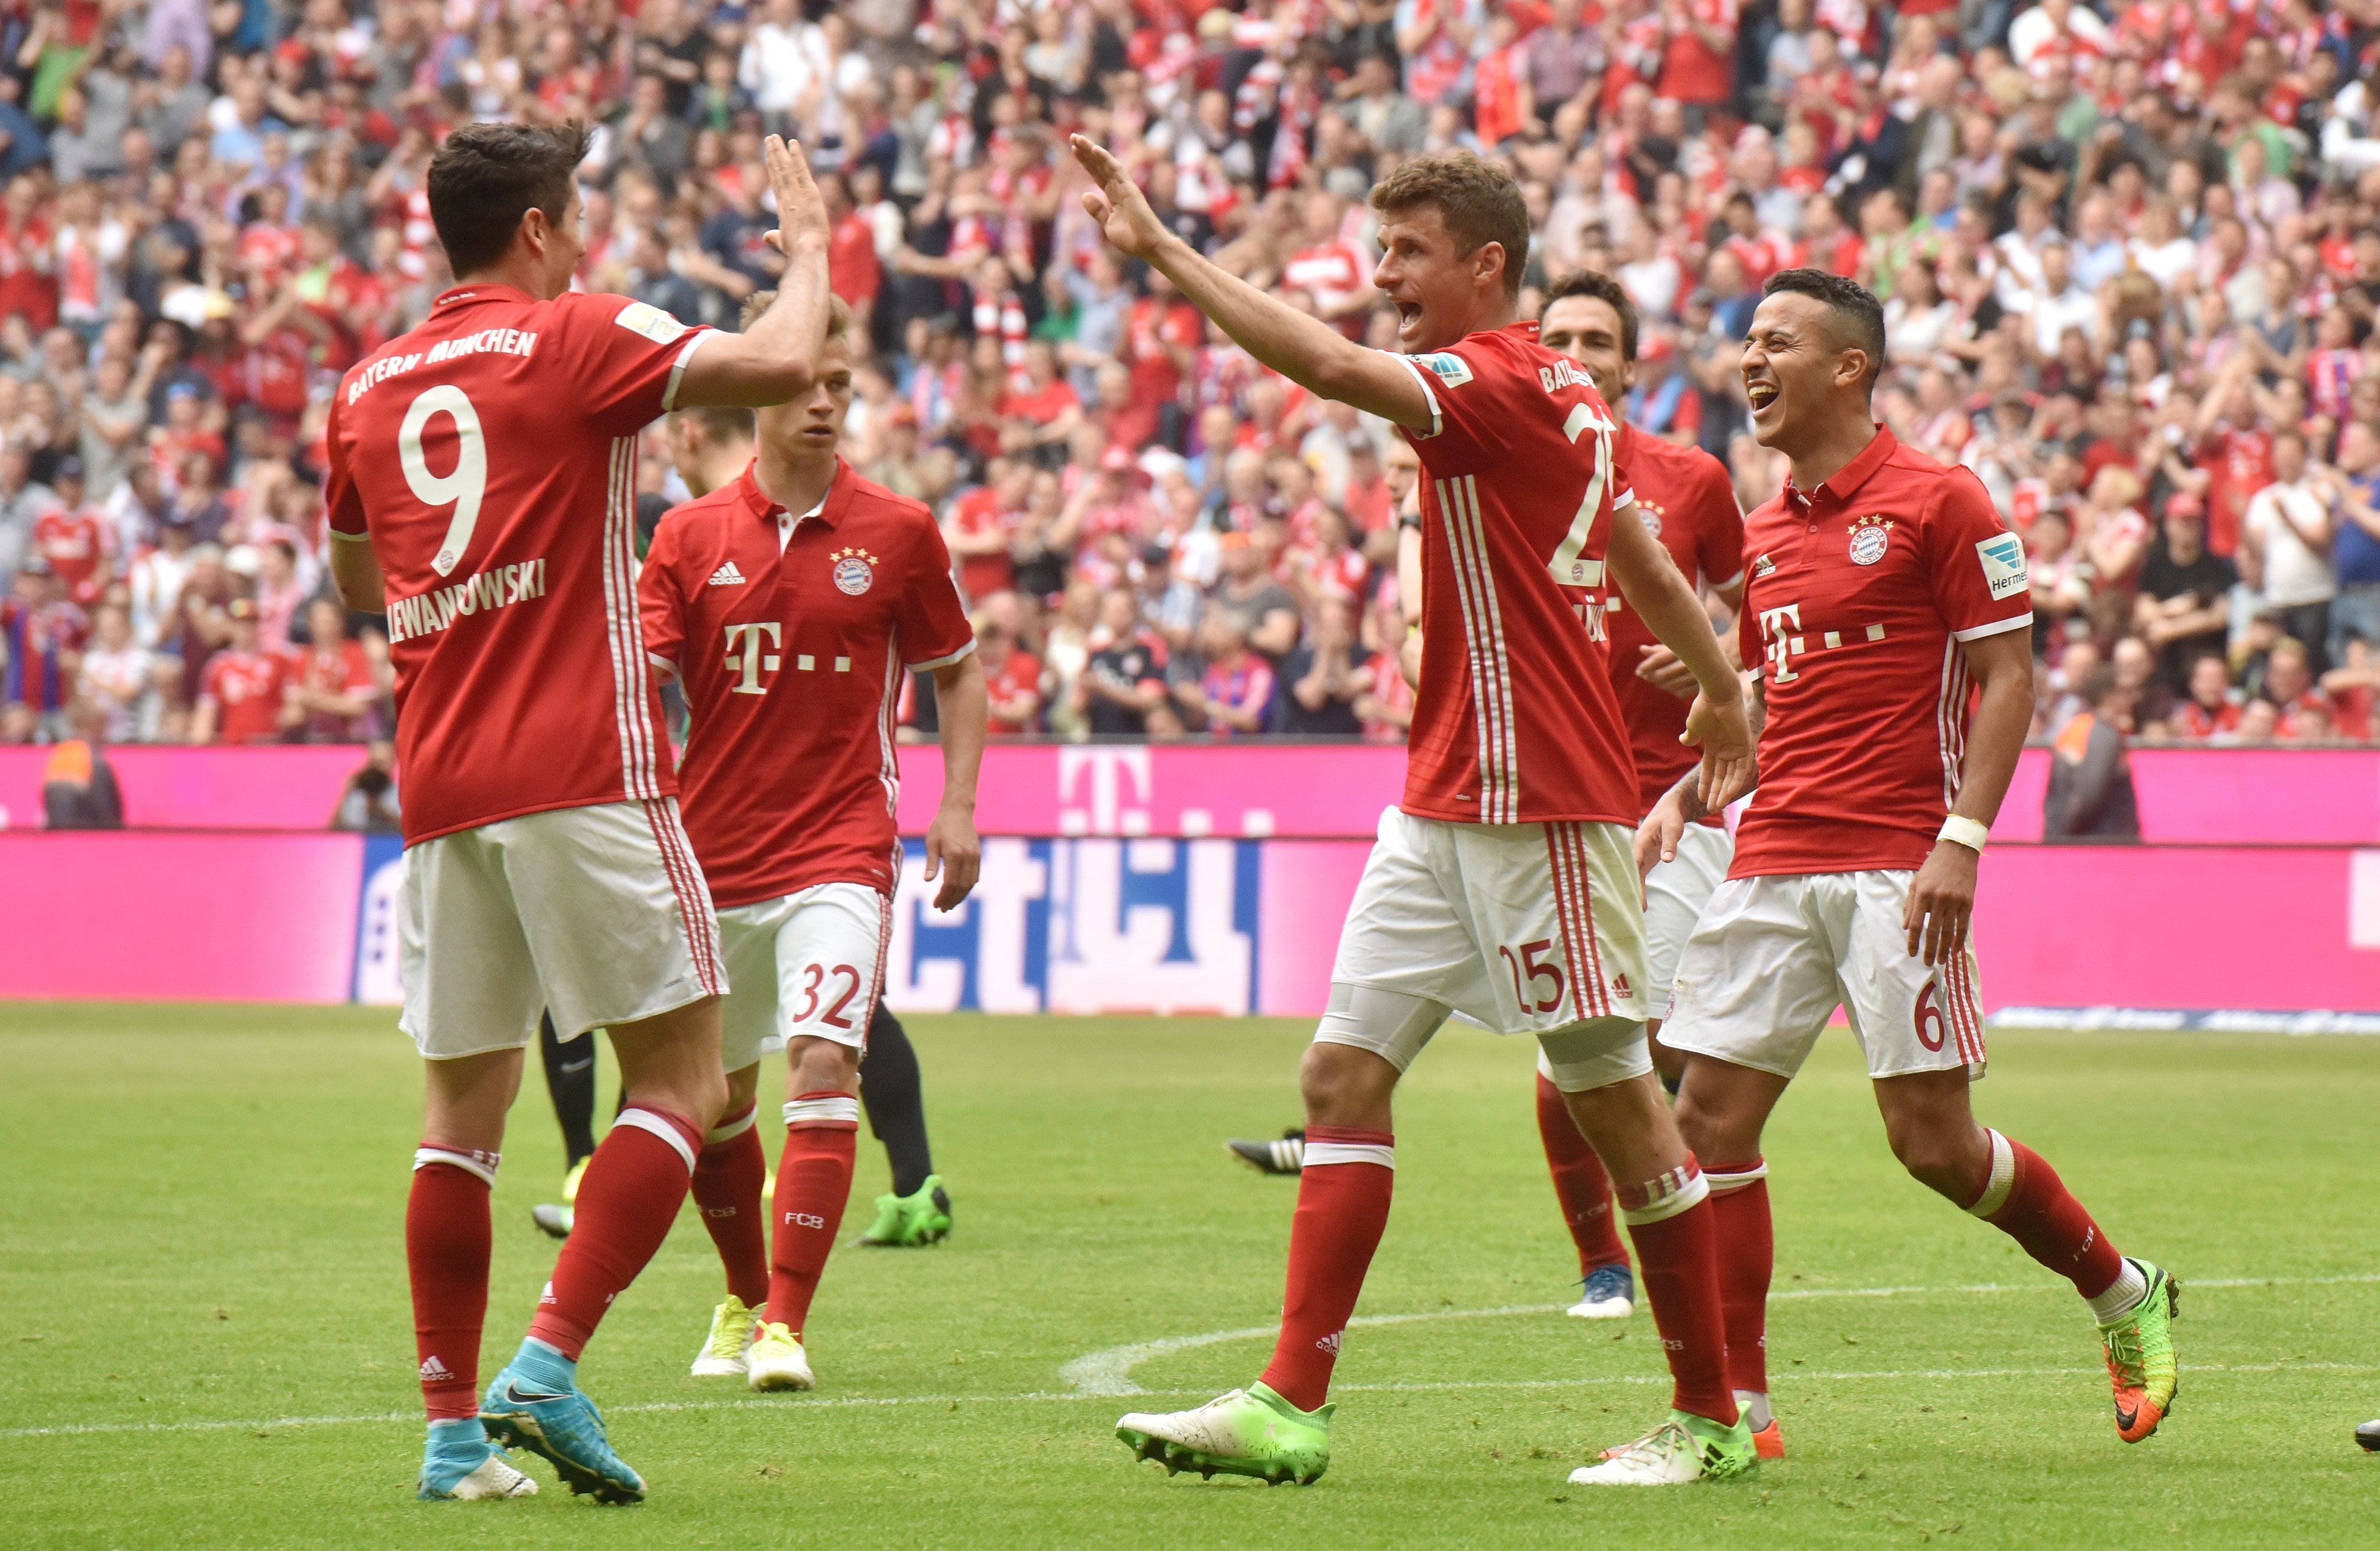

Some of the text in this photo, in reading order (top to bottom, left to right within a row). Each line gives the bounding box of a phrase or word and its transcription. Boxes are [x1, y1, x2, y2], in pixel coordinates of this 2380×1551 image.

[349, 353, 422, 406] BAYERN
[398, 384, 487, 577] 9
[1860, 529, 1885, 542] BAYERN
[708, 576, 746, 585] adidas
[1992, 571, 2027, 591] Hermes
[387, 558, 546, 644] LEWANDOWSKI
[793, 963, 860, 1029] 32
[1914, 980, 1945, 1053] 6
[785, 1212, 824, 1230] FCB
[1316, 1341, 1338, 1357] adid
[1659, 1338, 1684, 1351] CB
